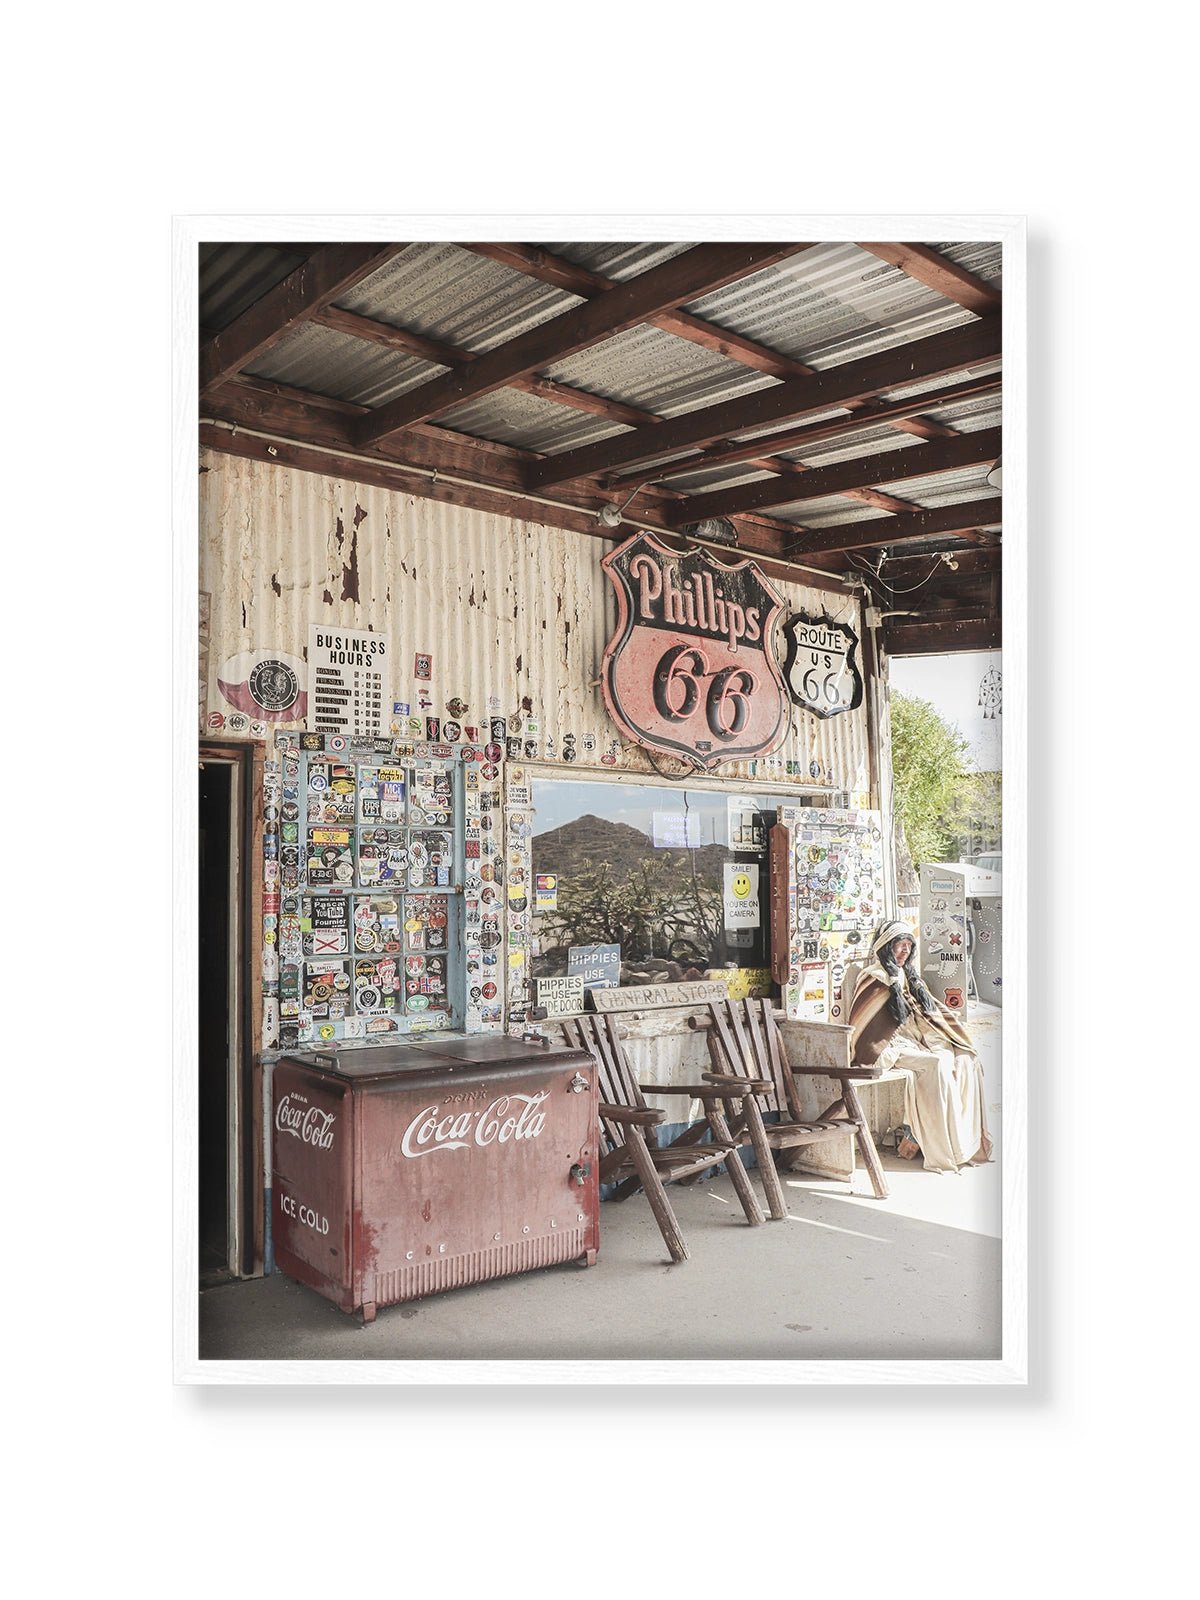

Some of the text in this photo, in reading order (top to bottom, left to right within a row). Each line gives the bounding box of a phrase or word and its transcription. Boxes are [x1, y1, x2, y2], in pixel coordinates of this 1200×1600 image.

[629, 553, 761, 653] Phillips
[316, 634, 386, 655] BUSINESS
[800, 626, 842, 650] ROUTE
[329, 651, 373, 667] HOURS
[653, 644, 761, 742] 66
[802, 669, 840, 705] 66
[932, 881, 953, 889] Phone
[729, 910, 755, 918] CAMERA
[571, 952, 618, 966] HIPPIES
[940, 952, 964, 962] DANKE
[585, 969, 605, 980] USE
[540, 978, 582, 990] HIPPIES
[551, 990, 571, 1000] USE
[600, 987, 675, 1009] GENERAL
[677, 984, 726, 1004] STORE
[560, 999, 583, 1012] DOOR
[444, 1089, 488, 1104] DRINK
[275, 1095, 337, 1152] Coca-Cola
[401, 1089, 551, 1159] Coca-Cola
[280, 1193, 330, 1236] ICE COLD
